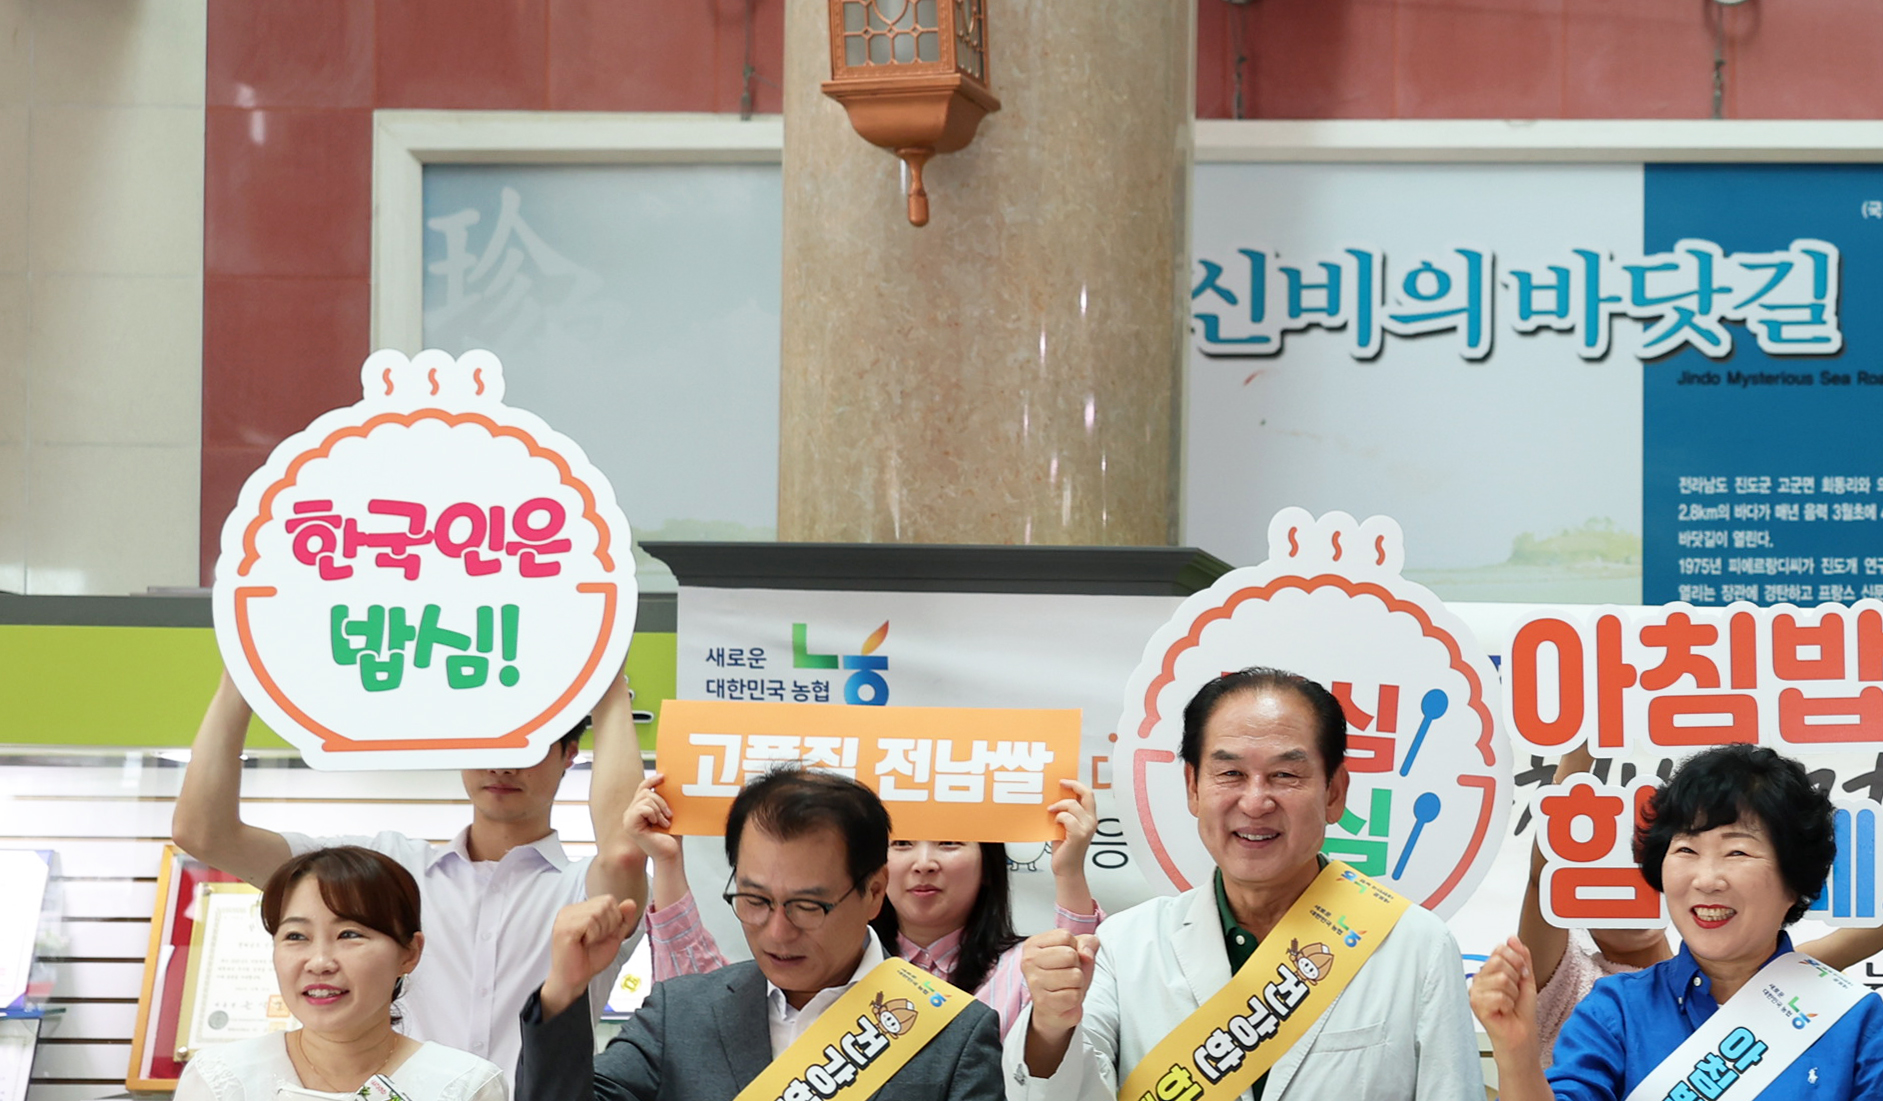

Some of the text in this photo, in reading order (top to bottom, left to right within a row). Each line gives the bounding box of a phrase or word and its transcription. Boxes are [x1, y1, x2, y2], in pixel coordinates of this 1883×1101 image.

[1677, 371, 1722, 386] Jindo
[1726, 371, 1814, 388] Mysterious
[1819, 371, 1851, 386] Sea
[1678, 476, 1728, 495] 전라남도
[1735, 476, 1772, 495] 진도군
[1778, 476, 1815, 495] 고군면
[1734, 503, 1770, 521] 바다가
[1775, 503, 1799, 521] 매년
[1804, 503, 1829, 521] 음력
[1832, 503, 1877, 521] 3월초에
[285, 497, 573, 582] 한국인은
[1678, 529, 1774, 548] 바닷길이 열린다.
[1678, 556, 1722, 575] 1975년
[1821, 556, 1858, 575] 진도개
[1678, 583, 1715, 602] 열리는
[1721, 583, 1759, 602] 장관에
[1764, 583, 1813, 602] 경탄하고
[1818, 583, 1855, 602] 프랑스
[330, 603, 521, 692] 밥심!
[705, 646, 767, 670] 새로운
[705, 679, 830, 703] 대한민국 농협
[873, 736, 1055, 805] 전남쌀
[1192, 962, 1311, 1085] 건강한
